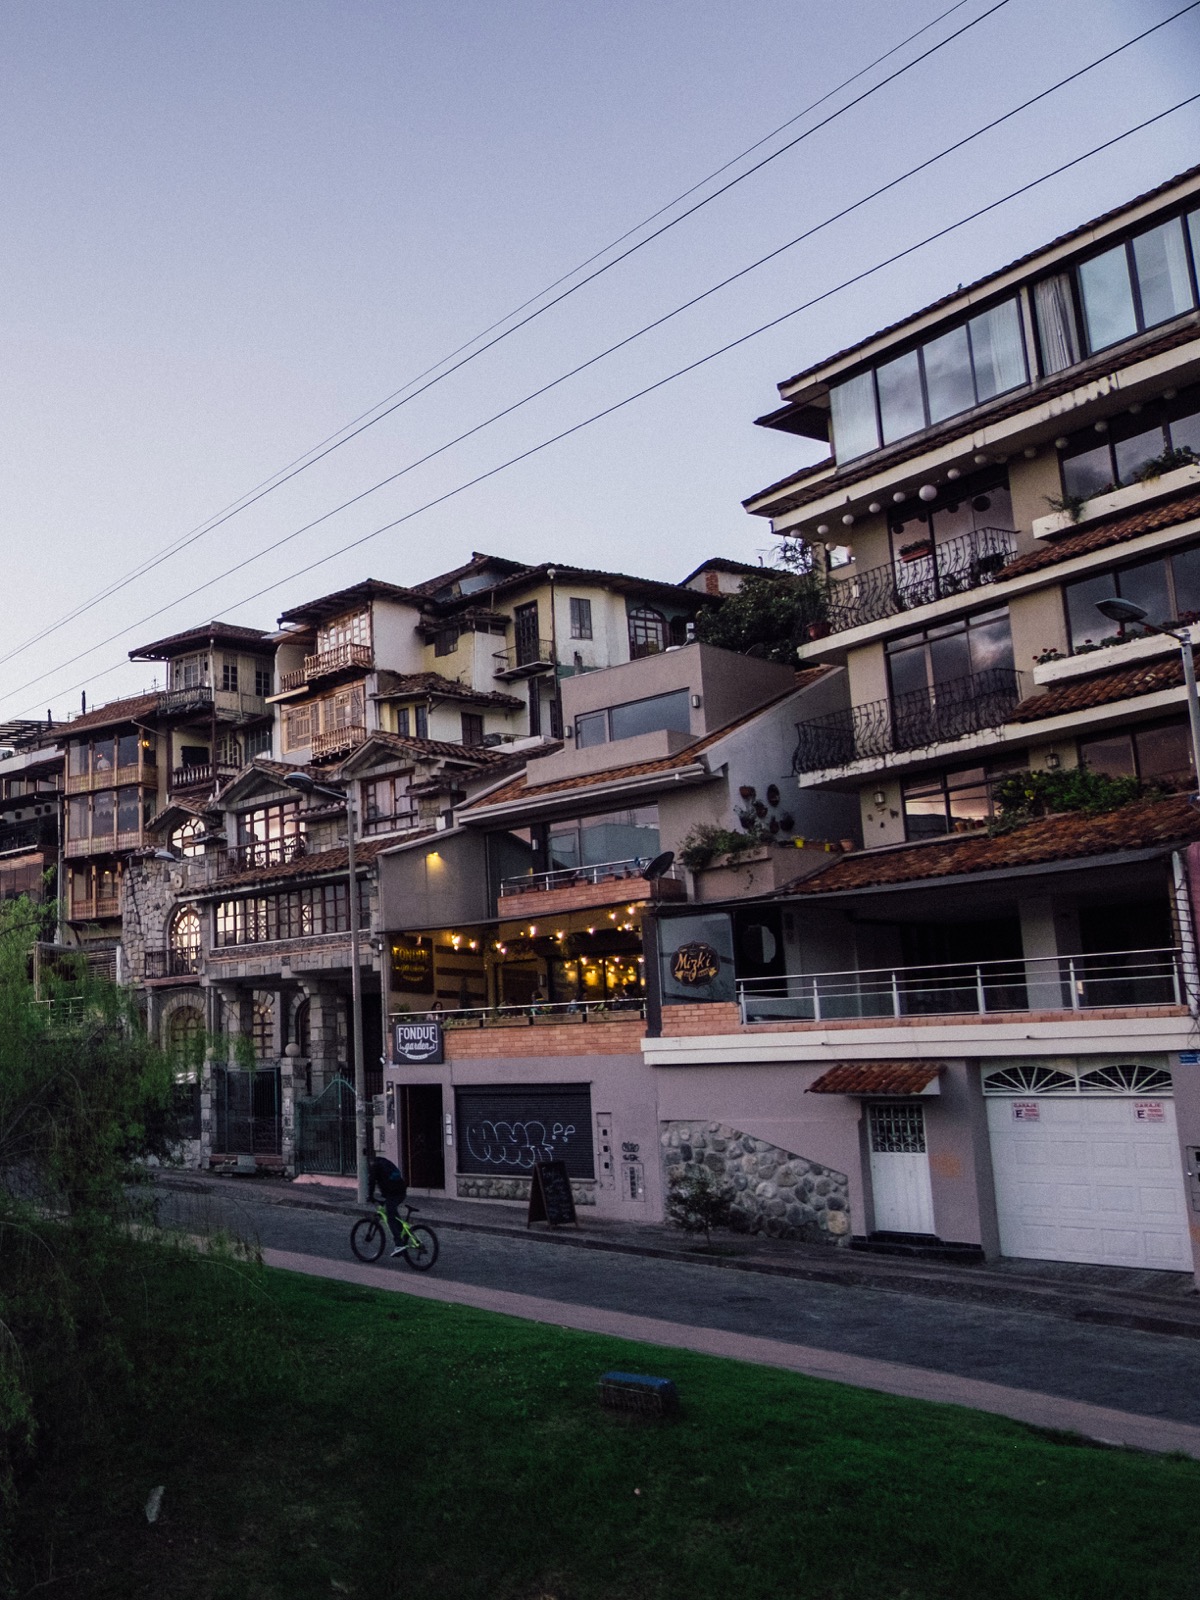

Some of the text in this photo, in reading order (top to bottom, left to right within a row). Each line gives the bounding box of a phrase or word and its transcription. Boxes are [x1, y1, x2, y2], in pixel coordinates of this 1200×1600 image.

[398, 1026, 438, 1043] FONDUE
[403, 1039, 431, 1053] garden
[1015, 1109, 1023, 1118] E
[1137, 1110, 1145, 1118] E
